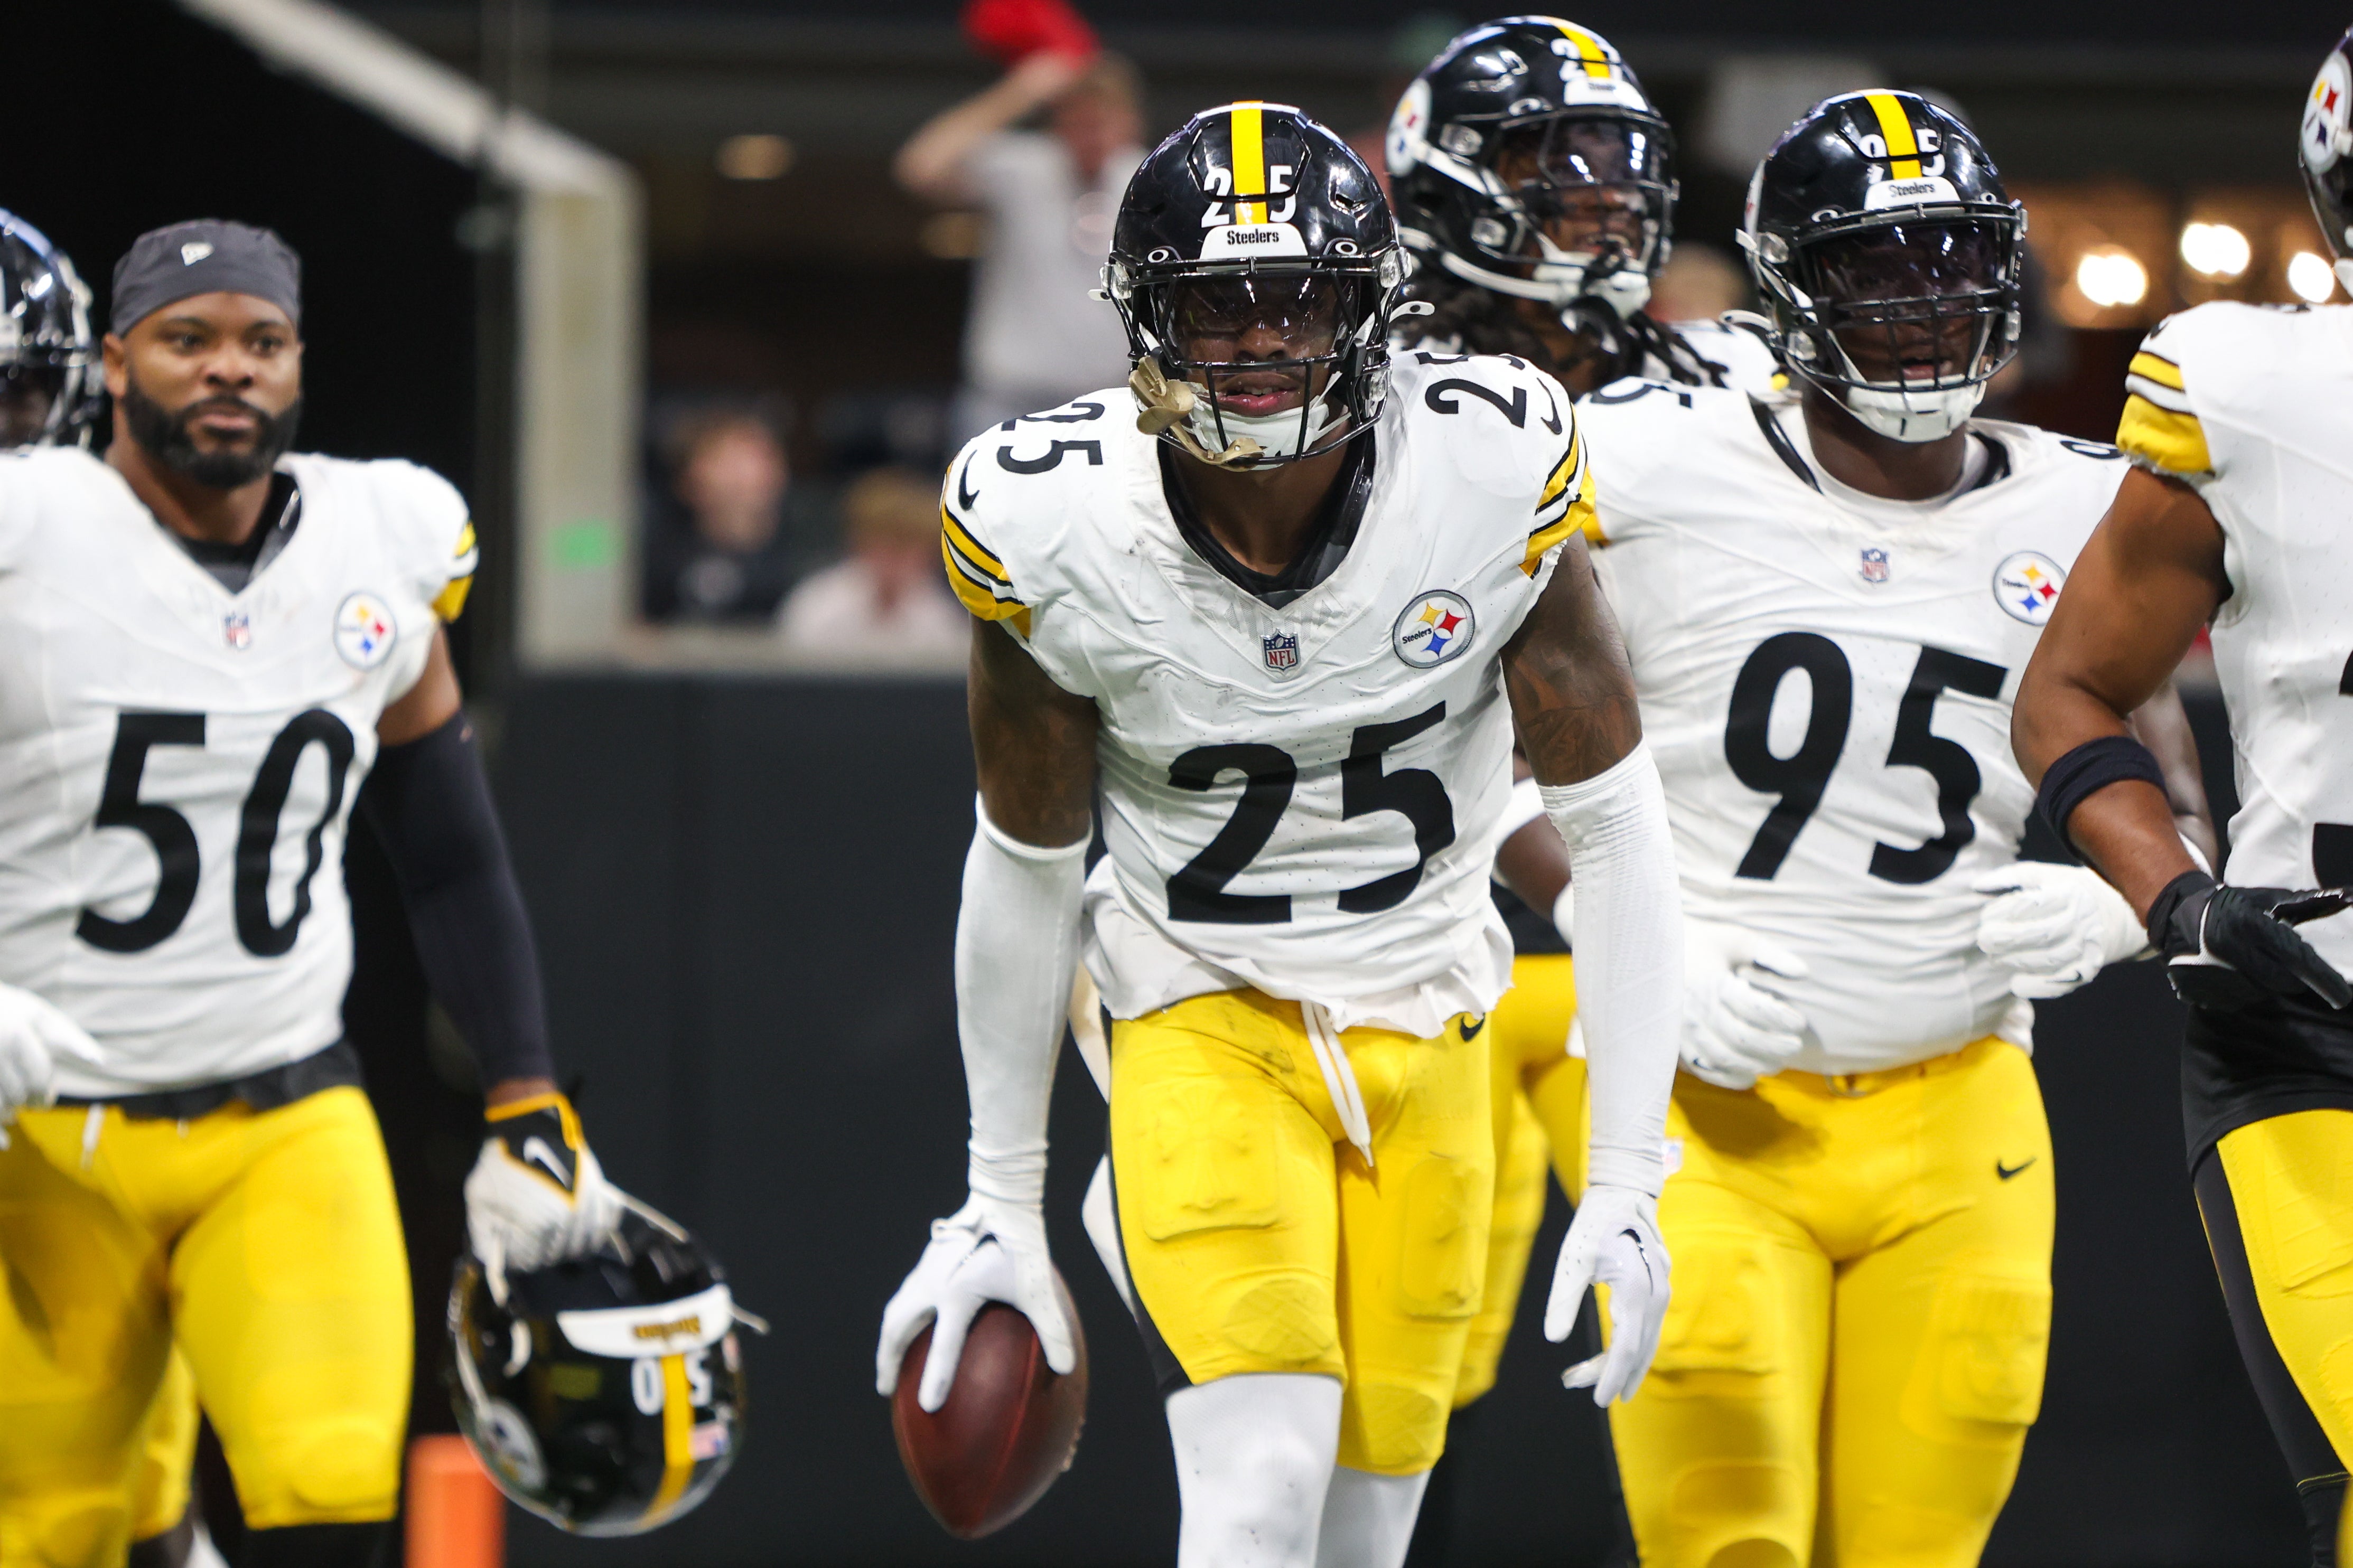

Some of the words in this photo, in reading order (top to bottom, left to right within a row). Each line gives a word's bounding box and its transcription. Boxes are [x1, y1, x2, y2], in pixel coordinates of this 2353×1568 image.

[1201, 165, 1296, 228] 25
[1227, 228, 1279, 245] Steelers
[996, 402, 1105, 474] 25
[1268, 650, 1295, 666] NFL
[1402, 628, 1432, 644] Steelers
[1724, 632, 2008, 885] 95
[75, 709, 354, 957] 50
[1167, 700, 1456, 924] 25
